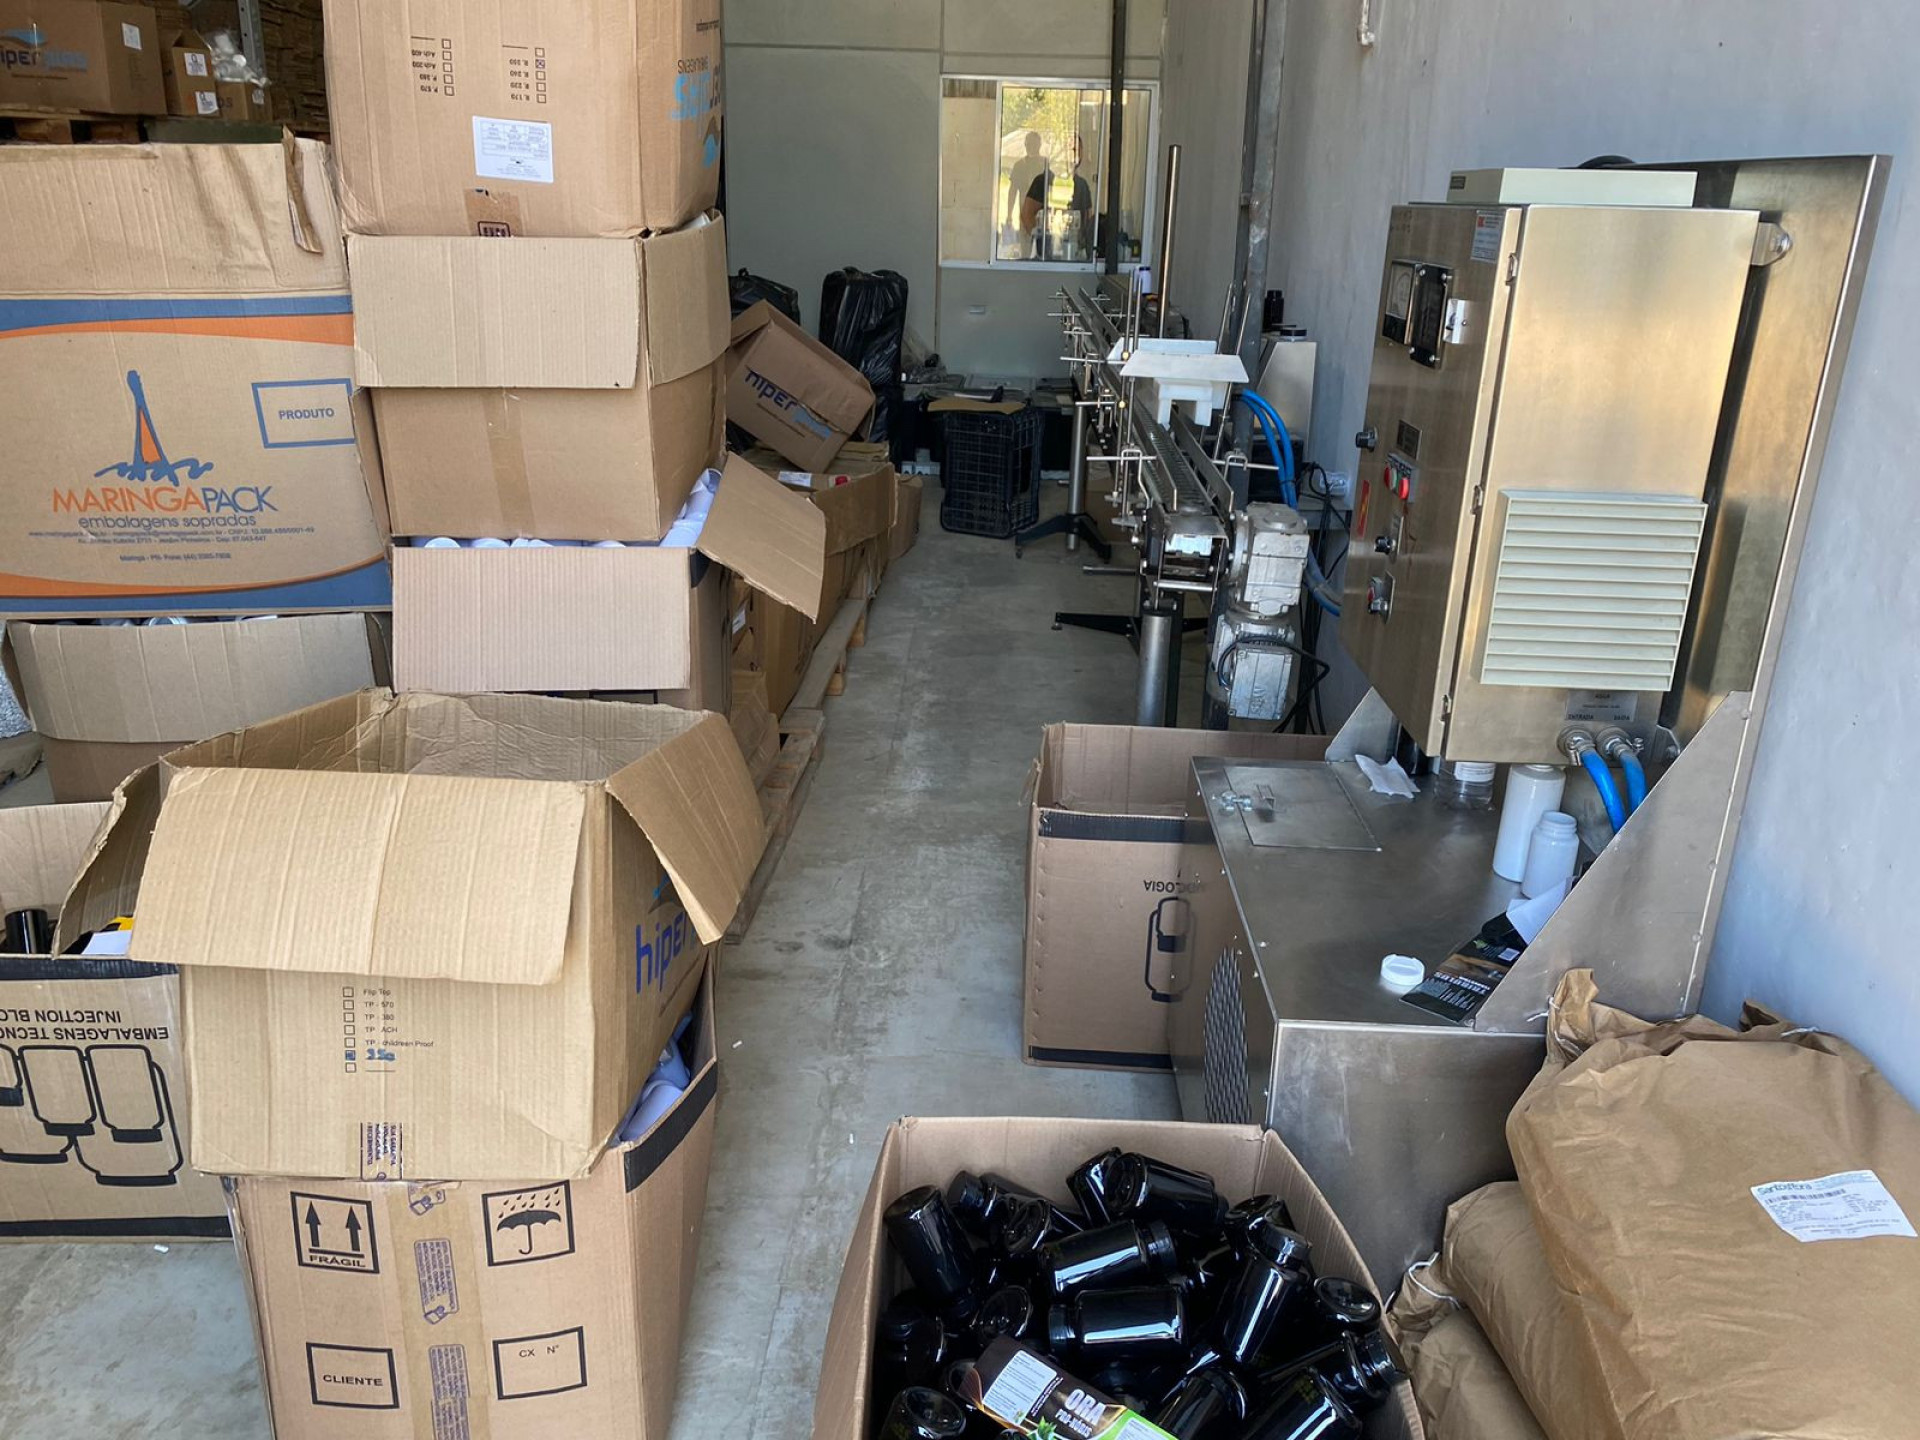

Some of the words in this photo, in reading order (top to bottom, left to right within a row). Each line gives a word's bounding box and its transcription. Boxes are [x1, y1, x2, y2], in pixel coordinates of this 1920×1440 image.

[278, 407, 335, 421] PRODUTO
[52, 484, 279, 514] MARINGAPACK
[78, 514, 179, 531] embalagens
[183, 513, 257, 529] sopradas
[35, 1009, 122, 1024] INJECTION
[54, 1026, 169, 1040] EMBALAGENS
[309, 1253, 367, 1269] FRÁGIL
[518, 1347, 536, 1359] CX
[322, 1373, 384, 1387] CLIENTE
[1064, 1388, 1107, 1426] ORA
